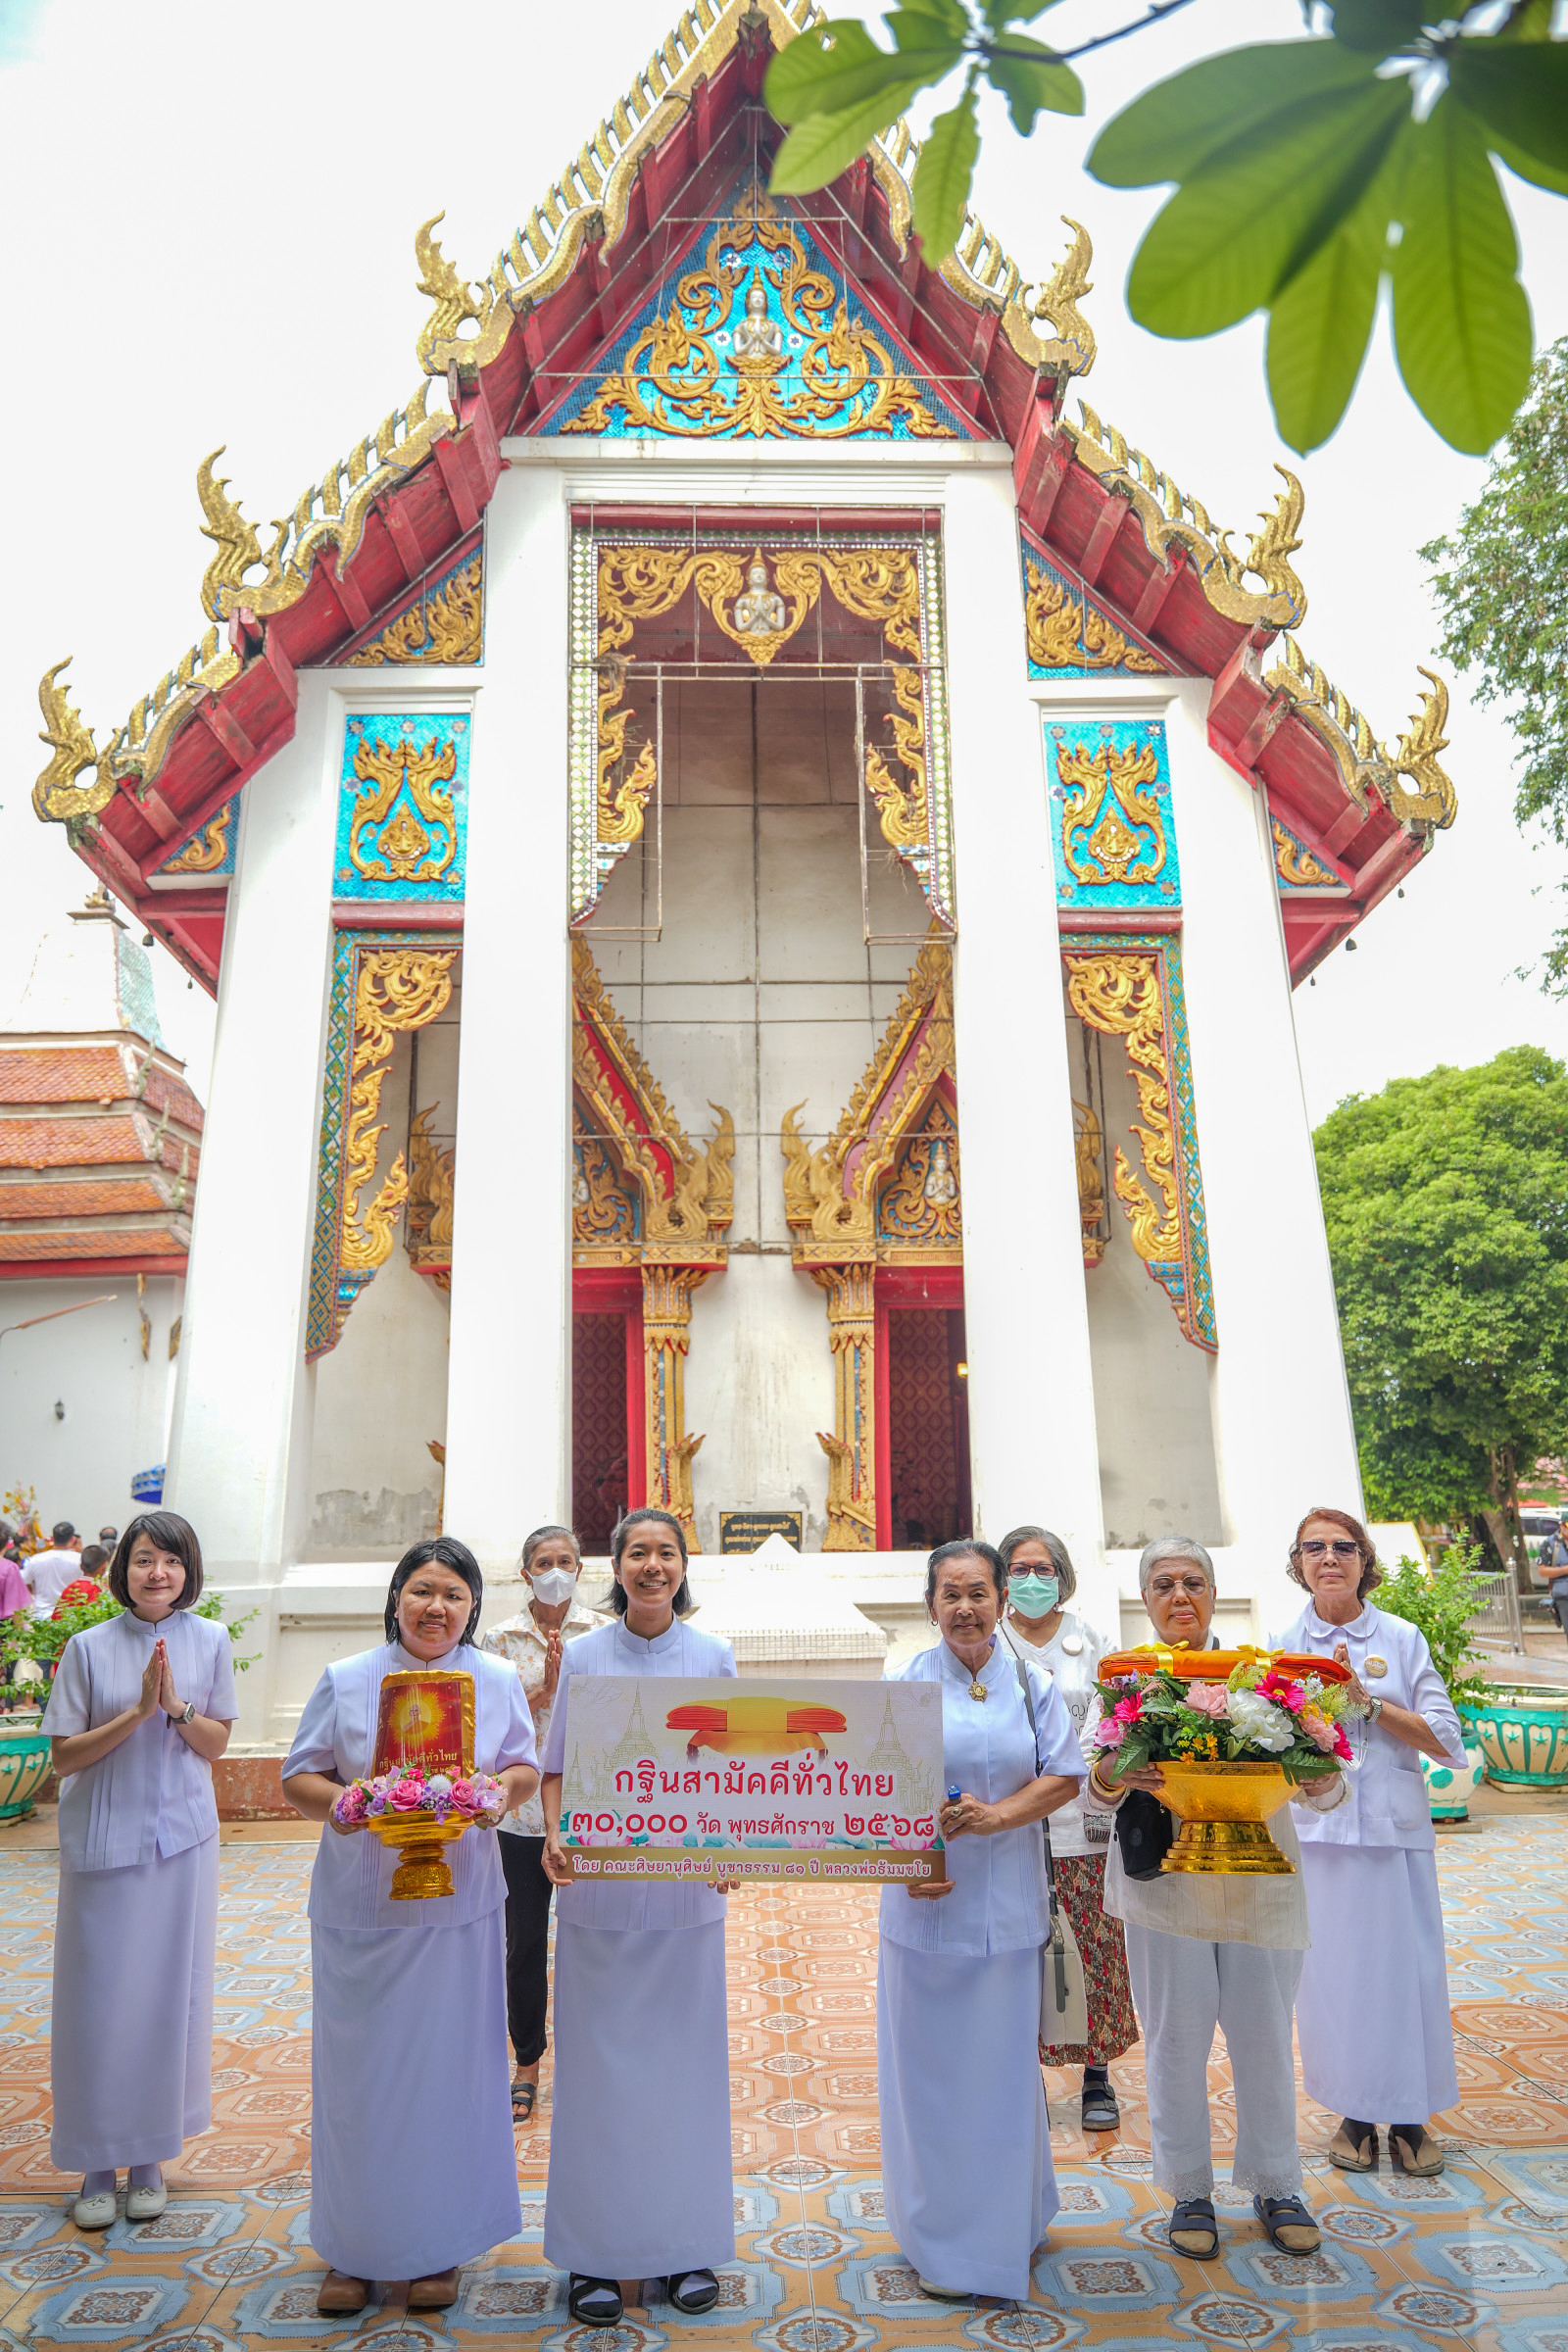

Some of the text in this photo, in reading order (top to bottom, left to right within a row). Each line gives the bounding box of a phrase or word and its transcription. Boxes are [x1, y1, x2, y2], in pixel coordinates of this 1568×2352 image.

[614, 1752, 894, 1804] กฐินสามัคคีทั่วไทย
[572, 1812, 935, 1842] ๓๐,๐๐๐ วัด พุทธศักราช ๒๕๖๘
[573, 1856, 930, 1878] โดย คณะศิษยานุศิษย์ บูชาธรรม ๘๑ ปี หลวงพ่อธัมมชโย
